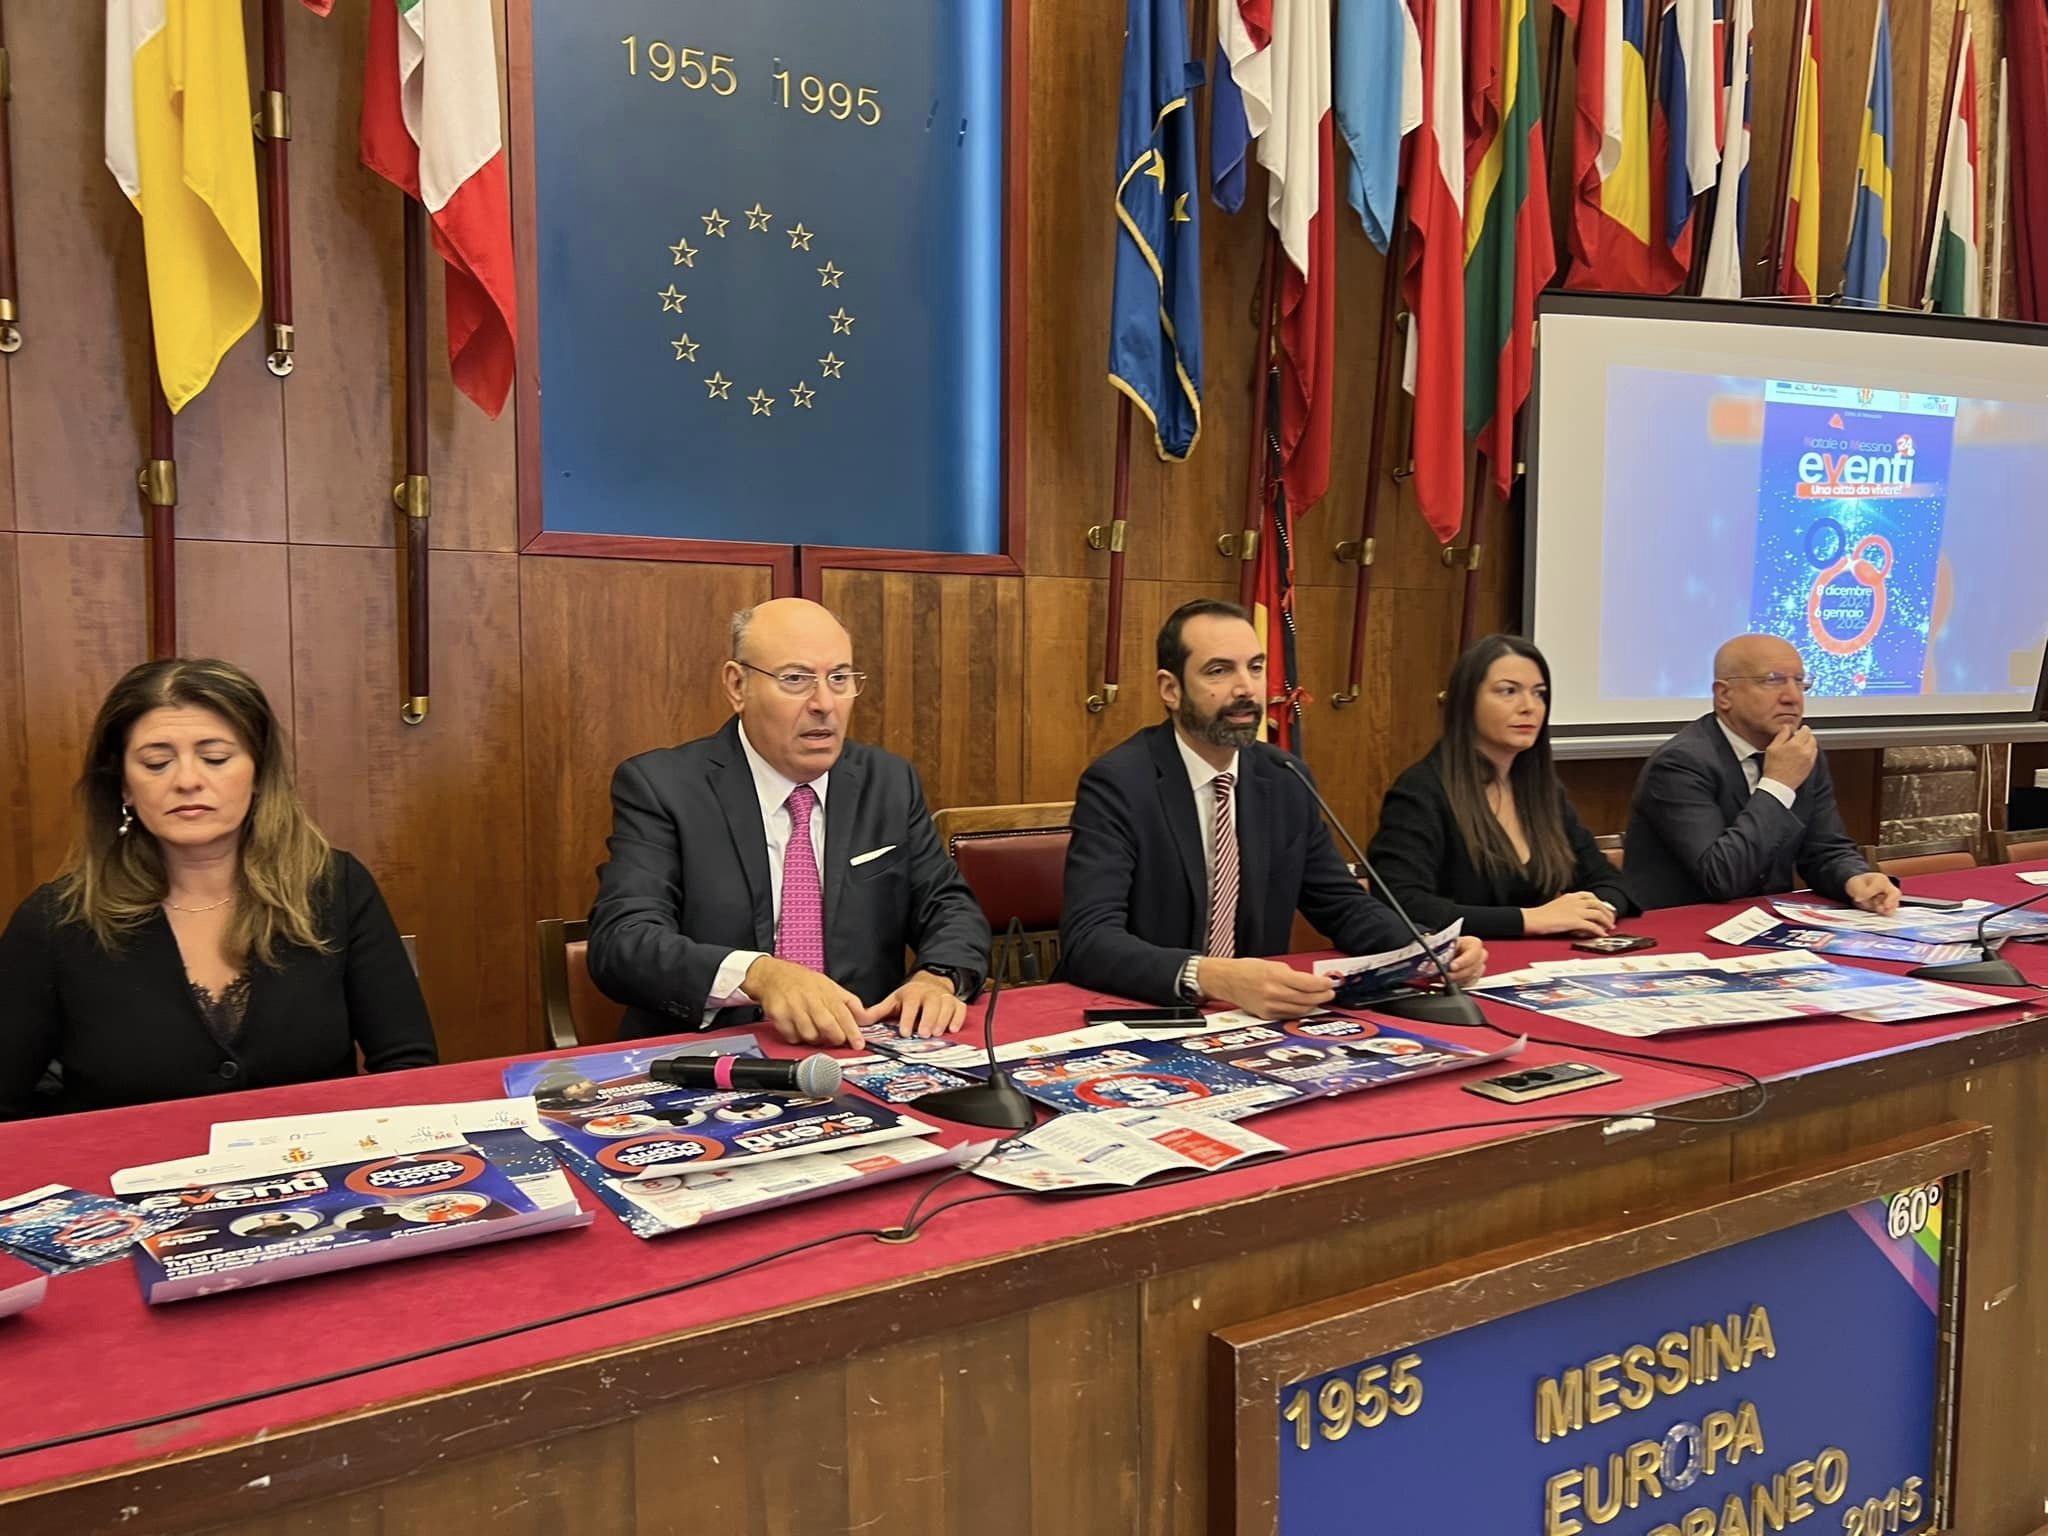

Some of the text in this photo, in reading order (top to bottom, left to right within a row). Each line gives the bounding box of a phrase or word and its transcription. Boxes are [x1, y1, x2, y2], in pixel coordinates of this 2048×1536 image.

[621, 34, 882, 127] 1955 1995
[1798, 451, 1915, 489] eventi
[1814, 606, 1865, 620] 6 gennaio
[1816, 584, 1873, 597] 8 dicembre
[1839, 596, 1871, 608] 2024
[1283, 1353, 1424, 1451] 1955
[1535, 1303, 1777, 1444] MESSINA
[1544, 1400, 1765, 1536] EUROPA
[1842, 1475, 1924, 1536] 2015
